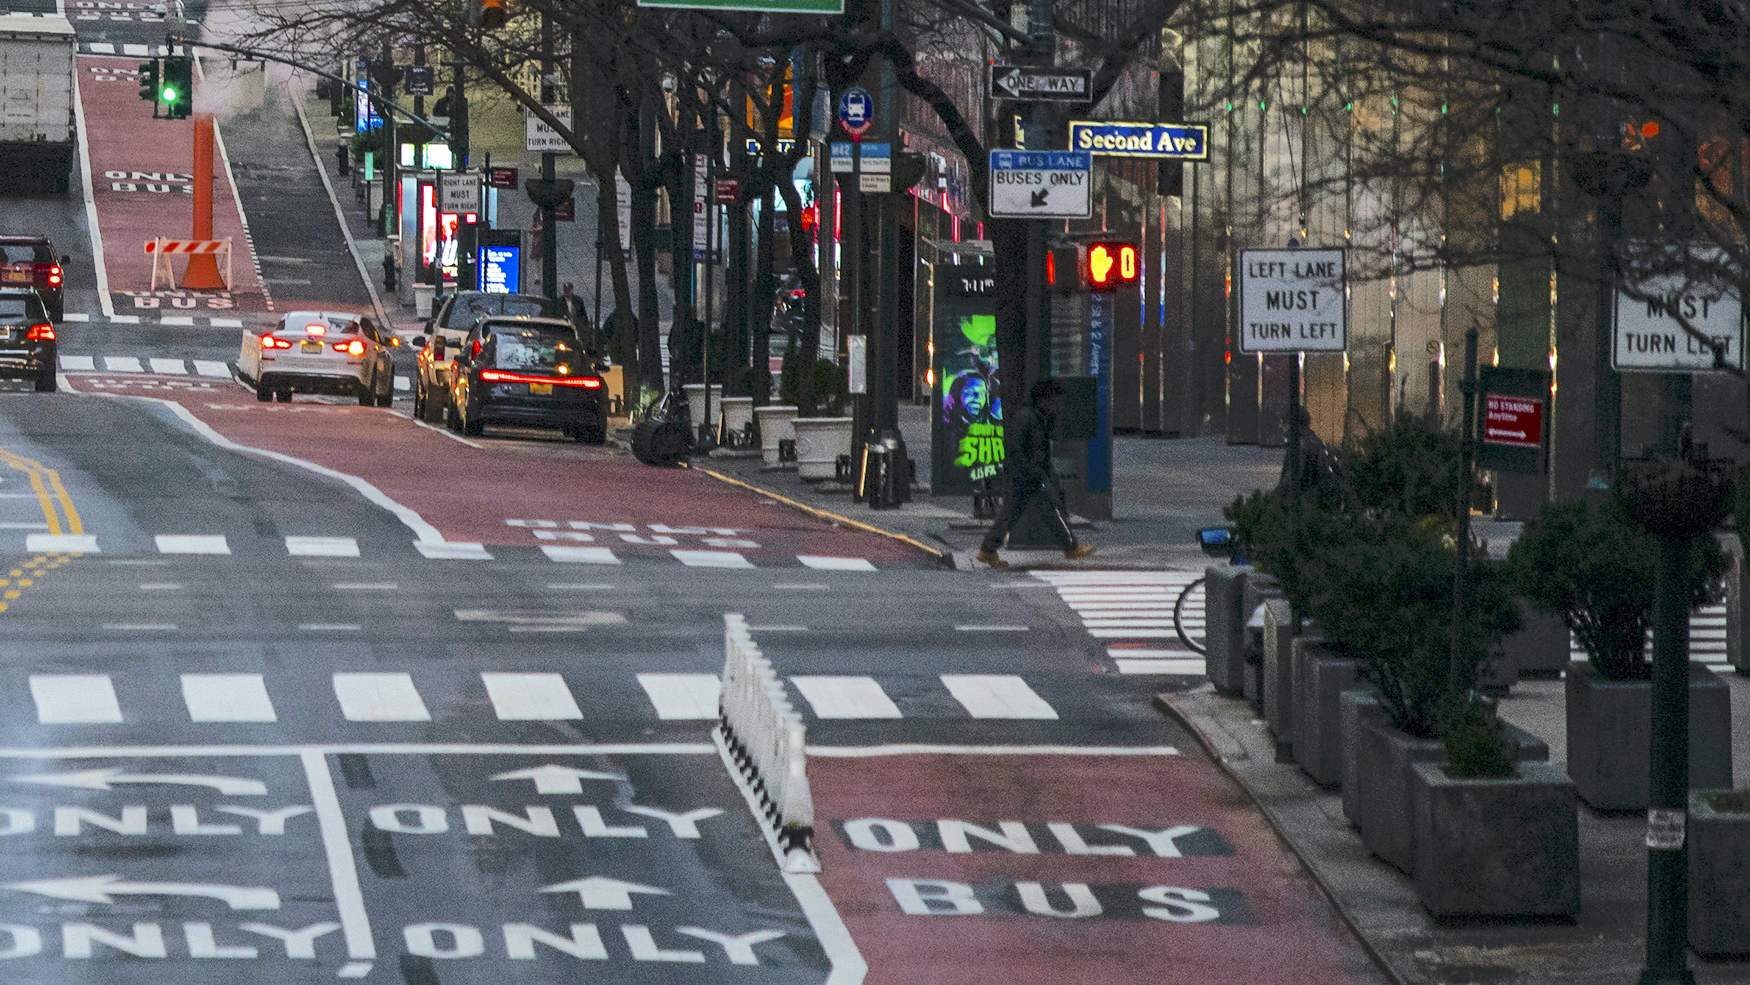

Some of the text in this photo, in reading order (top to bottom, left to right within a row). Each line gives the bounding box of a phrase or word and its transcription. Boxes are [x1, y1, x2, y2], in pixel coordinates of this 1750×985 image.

[1006, 75, 1080, 92] ONE WAY
[528, 138, 547, 146] TURN
[1079, 128, 1198, 153] Second Ave
[1018, 155, 1084, 168] BUS LANE
[444, 179, 477, 187] RIGHT LANE
[996, 171, 1085, 186] BUSES ONLY
[451, 190, 470, 199] MUST
[460, 203, 477, 211] RIGHT
[1249, 260, 1336, 279] LEFT LANE
[134, 296, 234, 309] BUS
[1266, 291, 1319, 311] MUST
[1250, 322, 1337, 341] TURN LEFT
[1626, 333, 1677, 354] TURN
[1488, 401, 1535, 414] NO STANDING
[368, 804, 724, 839] ONLY
[843, 816, 1201, 859] ONLY
[884, 876, 1221, 923] BUS
[402, 921, 790, 965] ONLY
